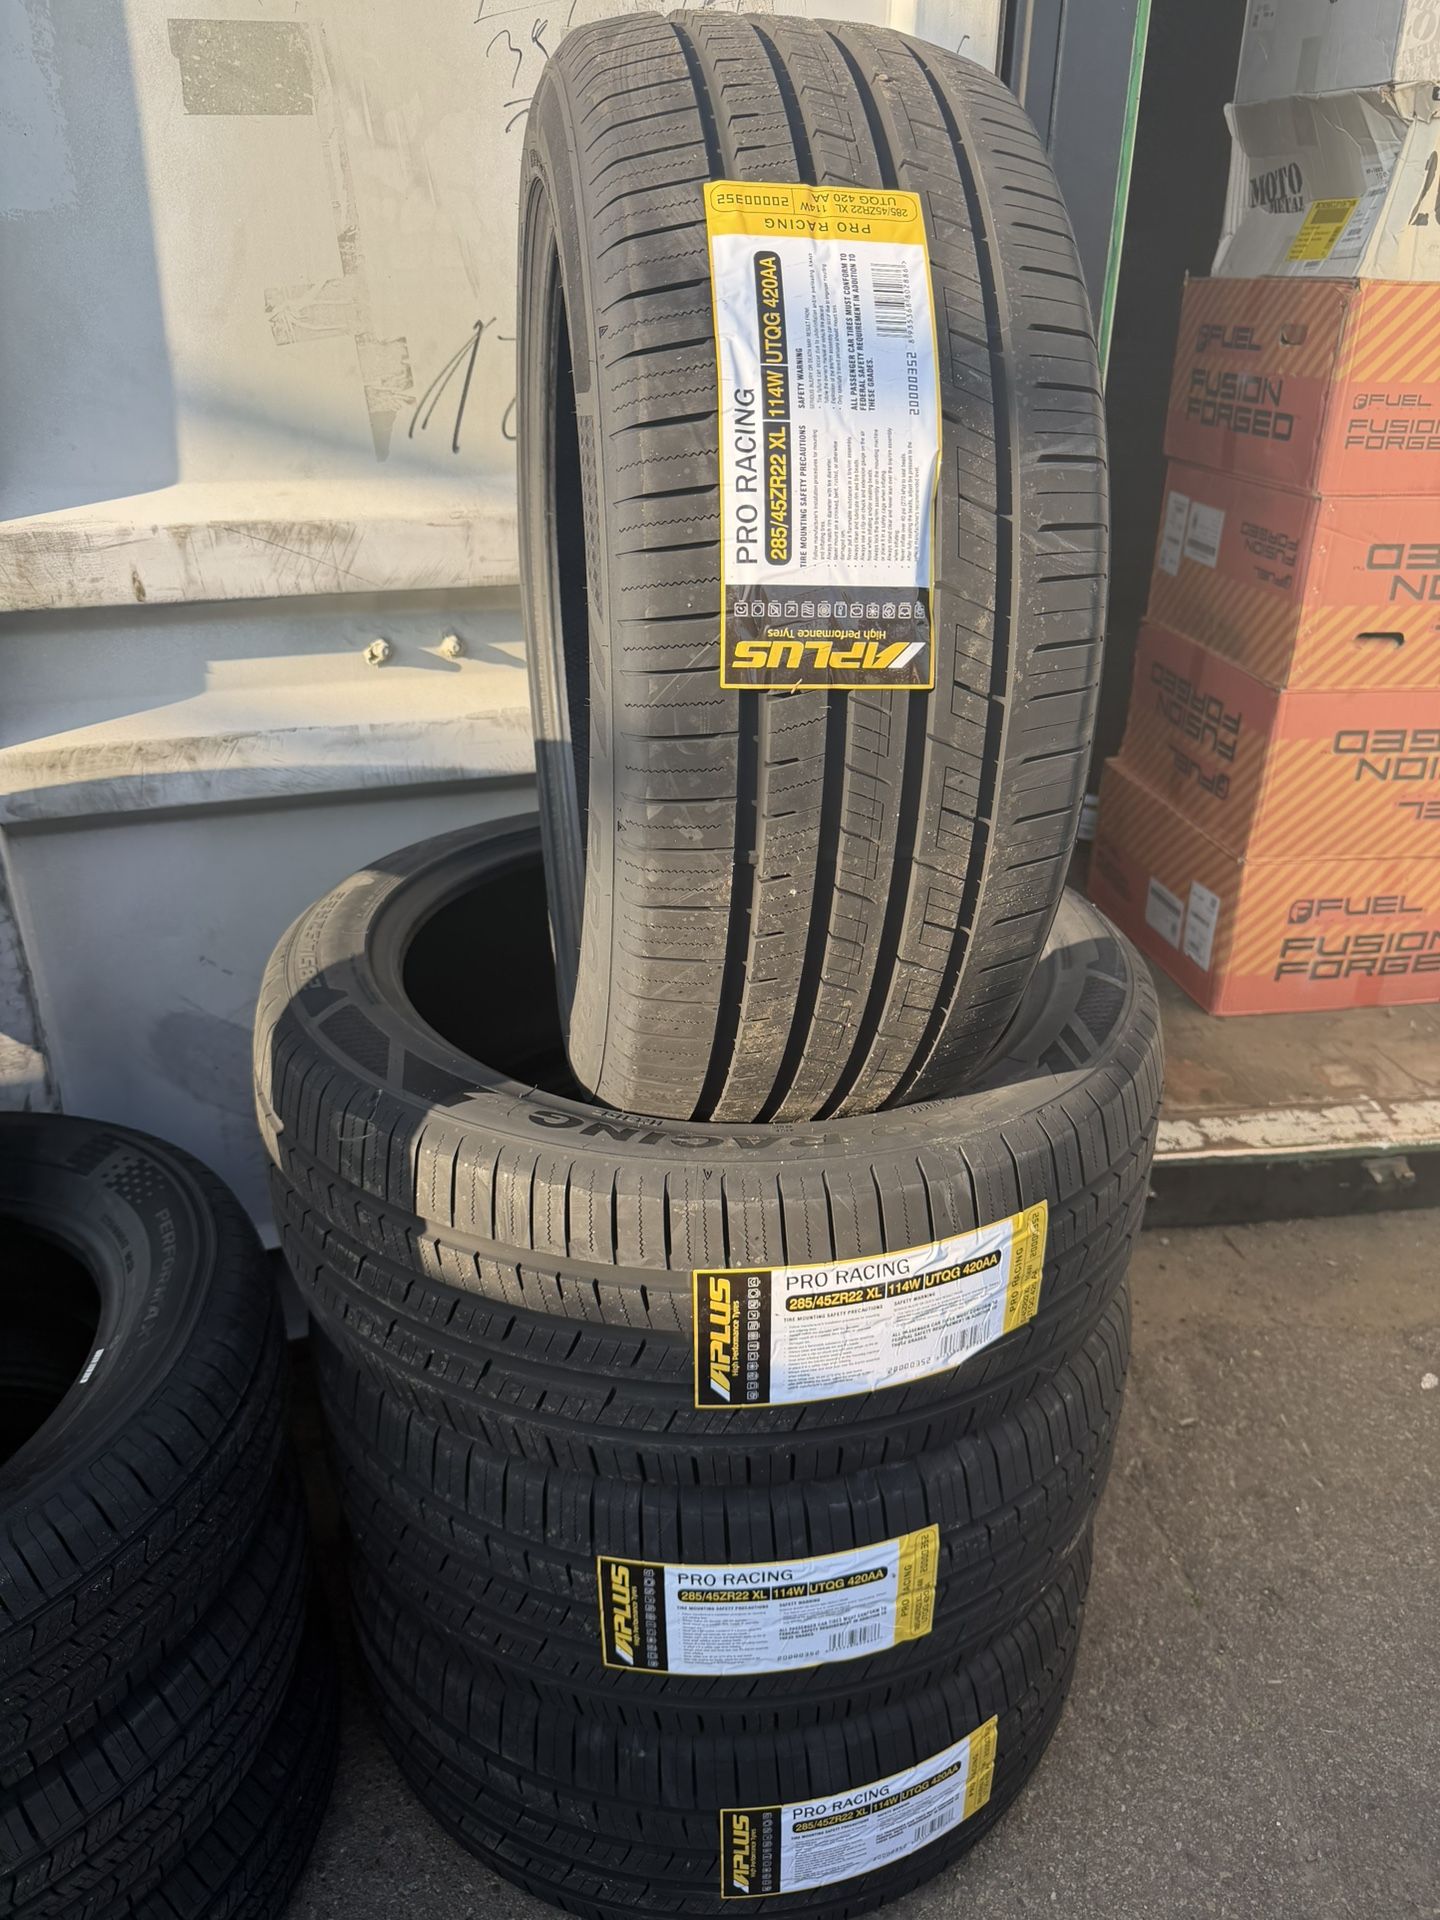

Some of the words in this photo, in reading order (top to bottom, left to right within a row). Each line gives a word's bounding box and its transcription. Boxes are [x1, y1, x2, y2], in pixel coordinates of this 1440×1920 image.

[717, 194, 789, 206] 20000352
[811, 193, 829, 202] AA
[834, 194, 855, 202] 420
[1250, 162, 1303, 208] MOTO
[800, 202, 826, 212] 114W
[835, 203, 851, 212] XL
[852, 205, 908, 216] 285/45ZR22
[859, 196, 896, 206] UTQG
[764, 218, 828, 231] RACING
[837, 222, 871, 234] PRO
[840, 253, 847, 261] TO
[759, 256, 779, 308] 420AA
[842, 263, 851, 295] CONFORM
[850, 264, 859, 293] ADDITION
[844, 297, 852, 315] MUST
[764, 312, 784, 363] UTQG
[846, 318, 854, 336] TIRES
[854, 304, 864, 350] REQUIREMENT
[1207, 324, 1261, 351] FUEL
[847, 339, 855, 352] CAR
[796, 348, 804, 380] WARNING
[848, 354, 857, 395] PASSENGER
[857, 352, 866, 378] SAFETY
[766, 370, 785, 417] 114W
[906, 352, 920, 415] 20000352
[1191, 368, 1283, 407] FUSION
[1367, 394, 1432, 407] FUEL
[1186, 397, 1293, 441] FORGED
[734, 388, 758, 493] RACING
[768, 427, 786, 450] XL
[799, 425, 807, 476] PRECAUTIONS
[770, 454, 789, 560] 285/45ZR22
[736, 504, 758, 564] PRO
[1240, 522, 1299, 547] FORGED
[1245, 539, 1297, 567] FUSION
[767, 628, 795, 640] Tyres
[797, 628, 859, 640] Performance
[861, 628, 887, 640] High
[732, 640, 926, 668] APLUS
[1152, 661, 1242, 735] FORGED
[1159, 691, 1237, 762] FUSION
[1313, 895, 1424, 916] FUEL
[528, 1109, 840, 1150] RACING
[786, 1272, 828, 1291] PRO
[836, 1258, 910, 1285] RACING
[789, 1290, 863, 1310] 285/45ZR22
[865, 1287, 882, 1299] XL
[888, 1277, 922, 1296] 114W
[926, 1266, 961, 1286] UTQG
[962, 1255, 998, 1274] 420AA
[1012, 1247, 1024, 1289] RACING
[1009, 1291, 1019, 1313] PRO
[709, 1276, 731, 1402] APLUS
[678, 1573, 716, 1586] PRO
[724, 1569, 793, 1586] RACING
[681, 1591, 750, 1601] 285/45ZR22
[752, 1590, 768, 1600] XL
[773, 1587, 805, 1598] 114W
[809, 1579, 845, 1593] UTQG
[847, 1570, 884, 1586] 420AA
[611, 1564, 634, 1665] APLUS
[793, 1805, 826, 1820] PRO
[832, 1784, 890, 1812] RACING
[795, 1812, 854, 1832] 285/45ZR22
[856, 1808, 868, 1817] XL
[872, 1795, 899, 1811] 114W
[902, 1782, 929, 1799] UTQG
[733, 1814, 750, 1893] APLUS
